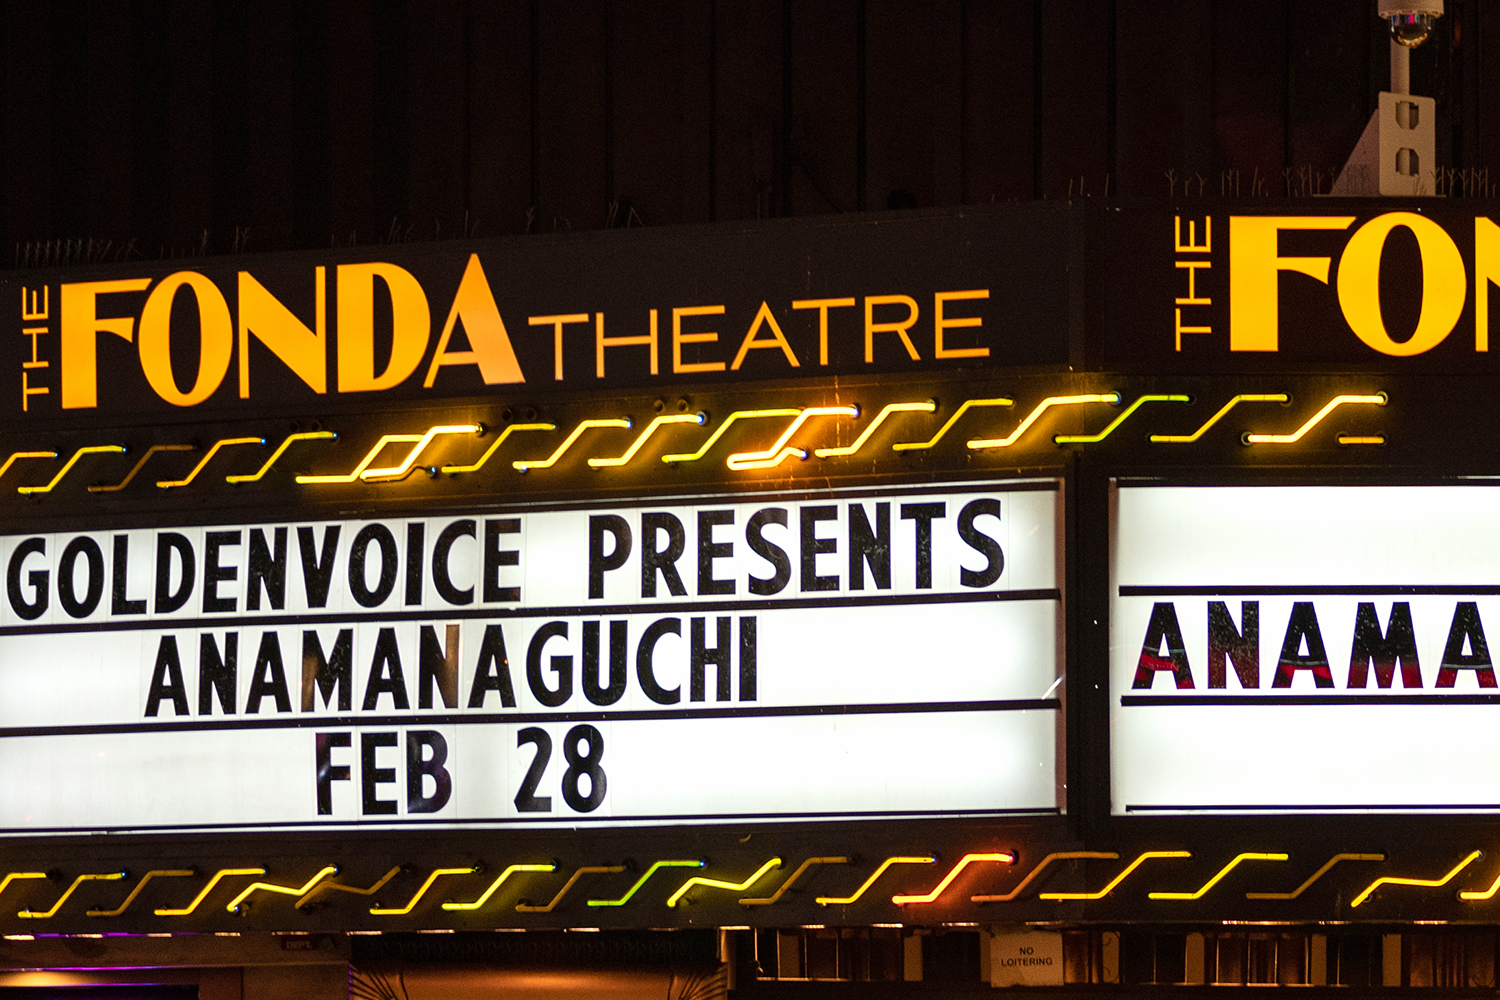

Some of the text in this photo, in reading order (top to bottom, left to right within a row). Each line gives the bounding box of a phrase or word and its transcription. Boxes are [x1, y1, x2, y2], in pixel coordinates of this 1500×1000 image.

[21, 253, 991, 411] THE FONDA THEATRE
[1175, 216, 1212, 351] THE
[6, 497, 1006, 621] GOLDENVOICE PRESENTS
[144, 615, 758, 718] ANAMANAGUCHI
[315, 723, 609, 816] FEB 28
[1001, 957, 1053, 966] LOITERING
[1020, 946, 1034, 955] NO
